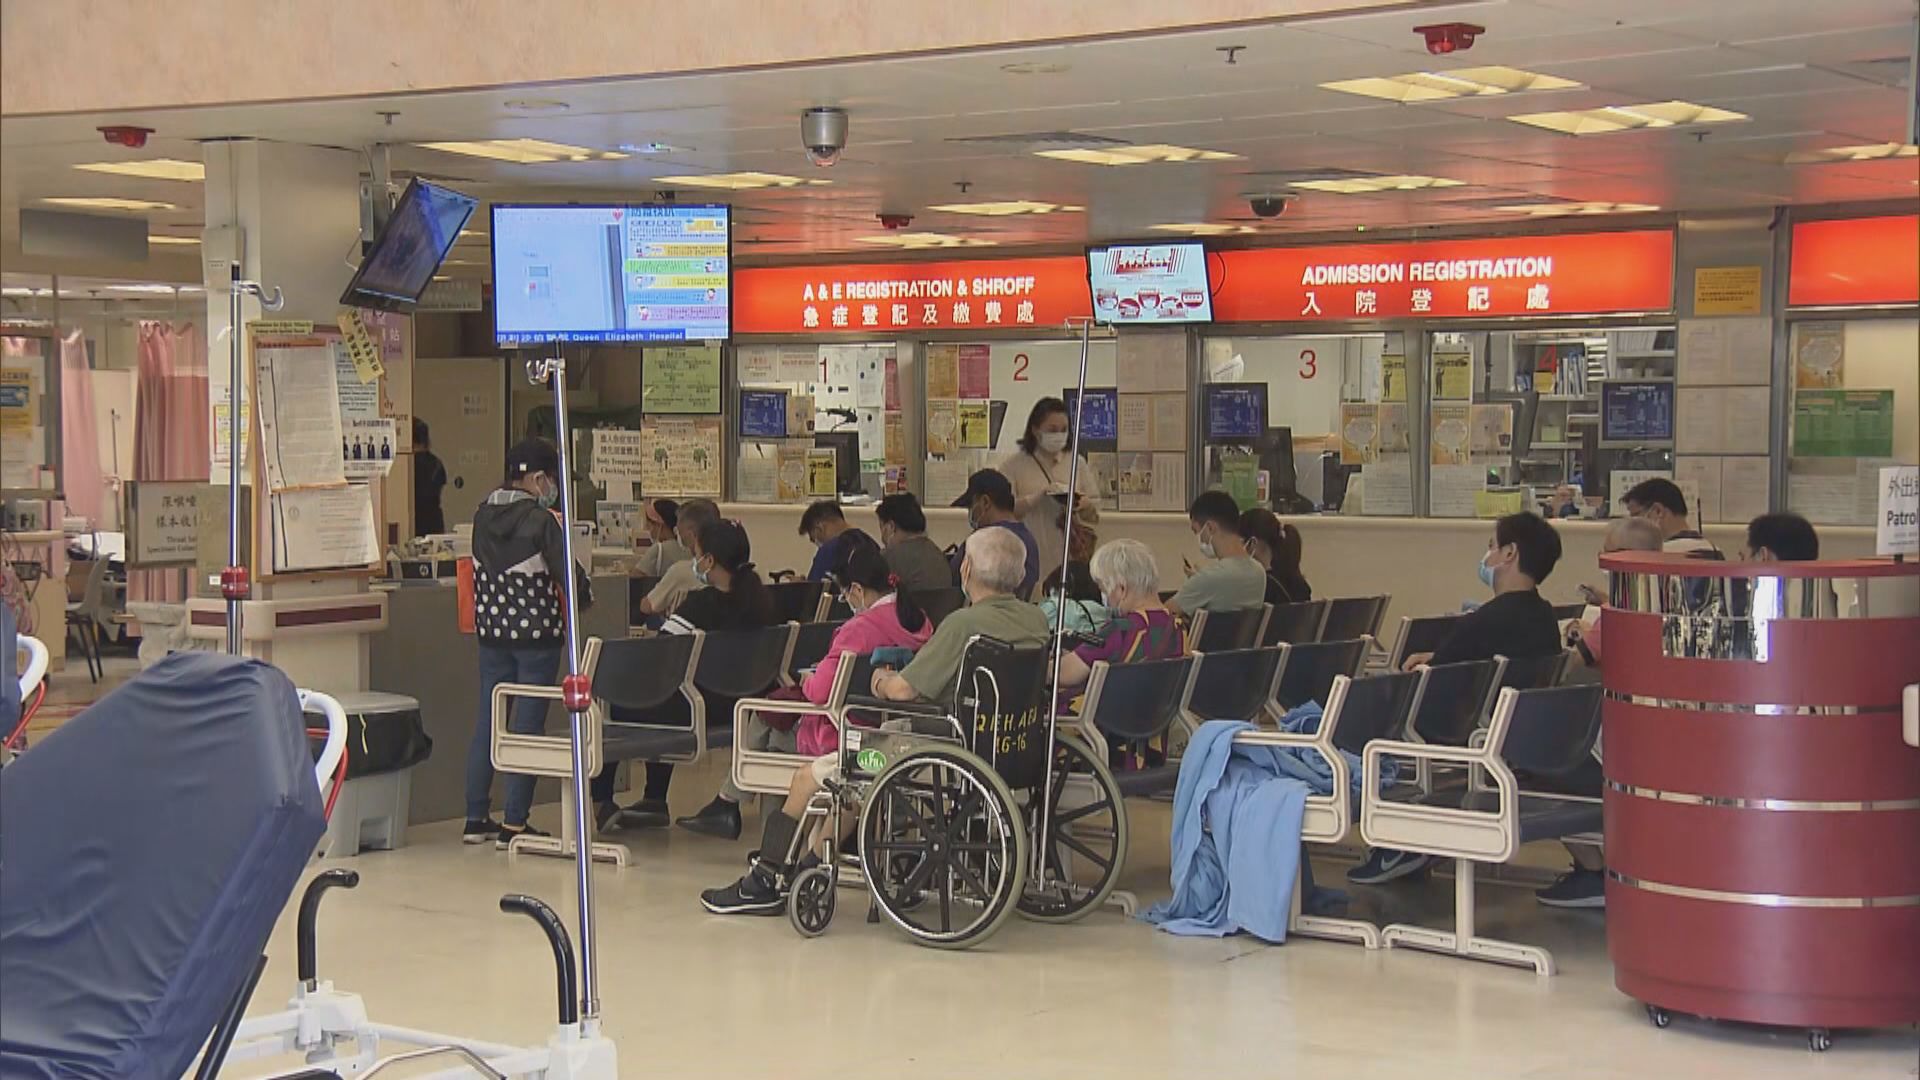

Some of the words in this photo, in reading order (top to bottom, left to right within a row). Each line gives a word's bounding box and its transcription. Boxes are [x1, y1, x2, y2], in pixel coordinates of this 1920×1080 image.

[1302, 263, 1404, 286] ADMISSION
[1409, 256, 1552, 281] REGISTRATION
[803, 283, 814, 301] A
[817, 282, 829, 301] &
[832, 281, 842, 300] E
[846, 279, 953, 300] REGISTRATION
[956, 278, 968, 296] &
[972, 276, 1035, 296] SHROFF
[1301, 284, 1550, 316] 入院登記處
[803, 300, 1035, 328] 急症登記及繳費處
[572, 333, 600, 342] Queen
[605, 332, 644, 342] Elizabeth
[649, 331, 683, 342] Hospital
[819, 356, 827, 384] 1
[1013, 353, 1029, 381] 2
[1299, 349, 1316, 379] 3
[1539, 344, 1558, 375] 4
[1887, 508, 1919, 527] Patrol
